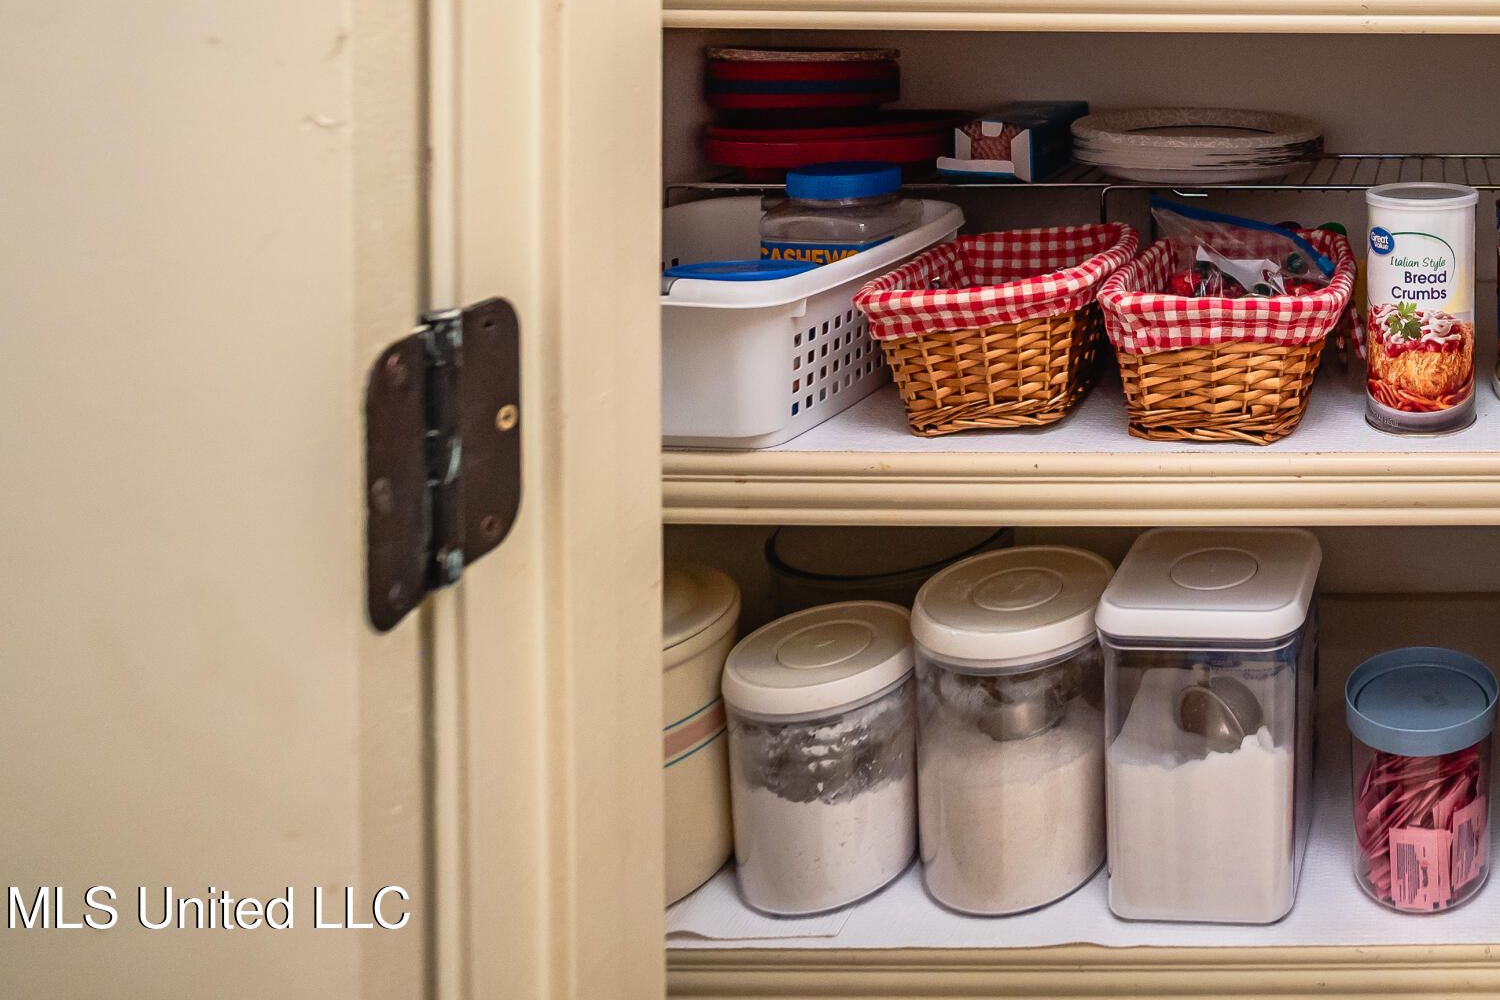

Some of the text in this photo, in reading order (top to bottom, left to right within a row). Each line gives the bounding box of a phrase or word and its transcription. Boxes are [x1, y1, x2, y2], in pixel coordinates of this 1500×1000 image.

[1370, 233, 1388, 245] Great
[1390, 256, 1446, 273] Italian Style
[1404, 271, 1447, 284] Bread
[1391, 286, 1447, 299] Crumbs
